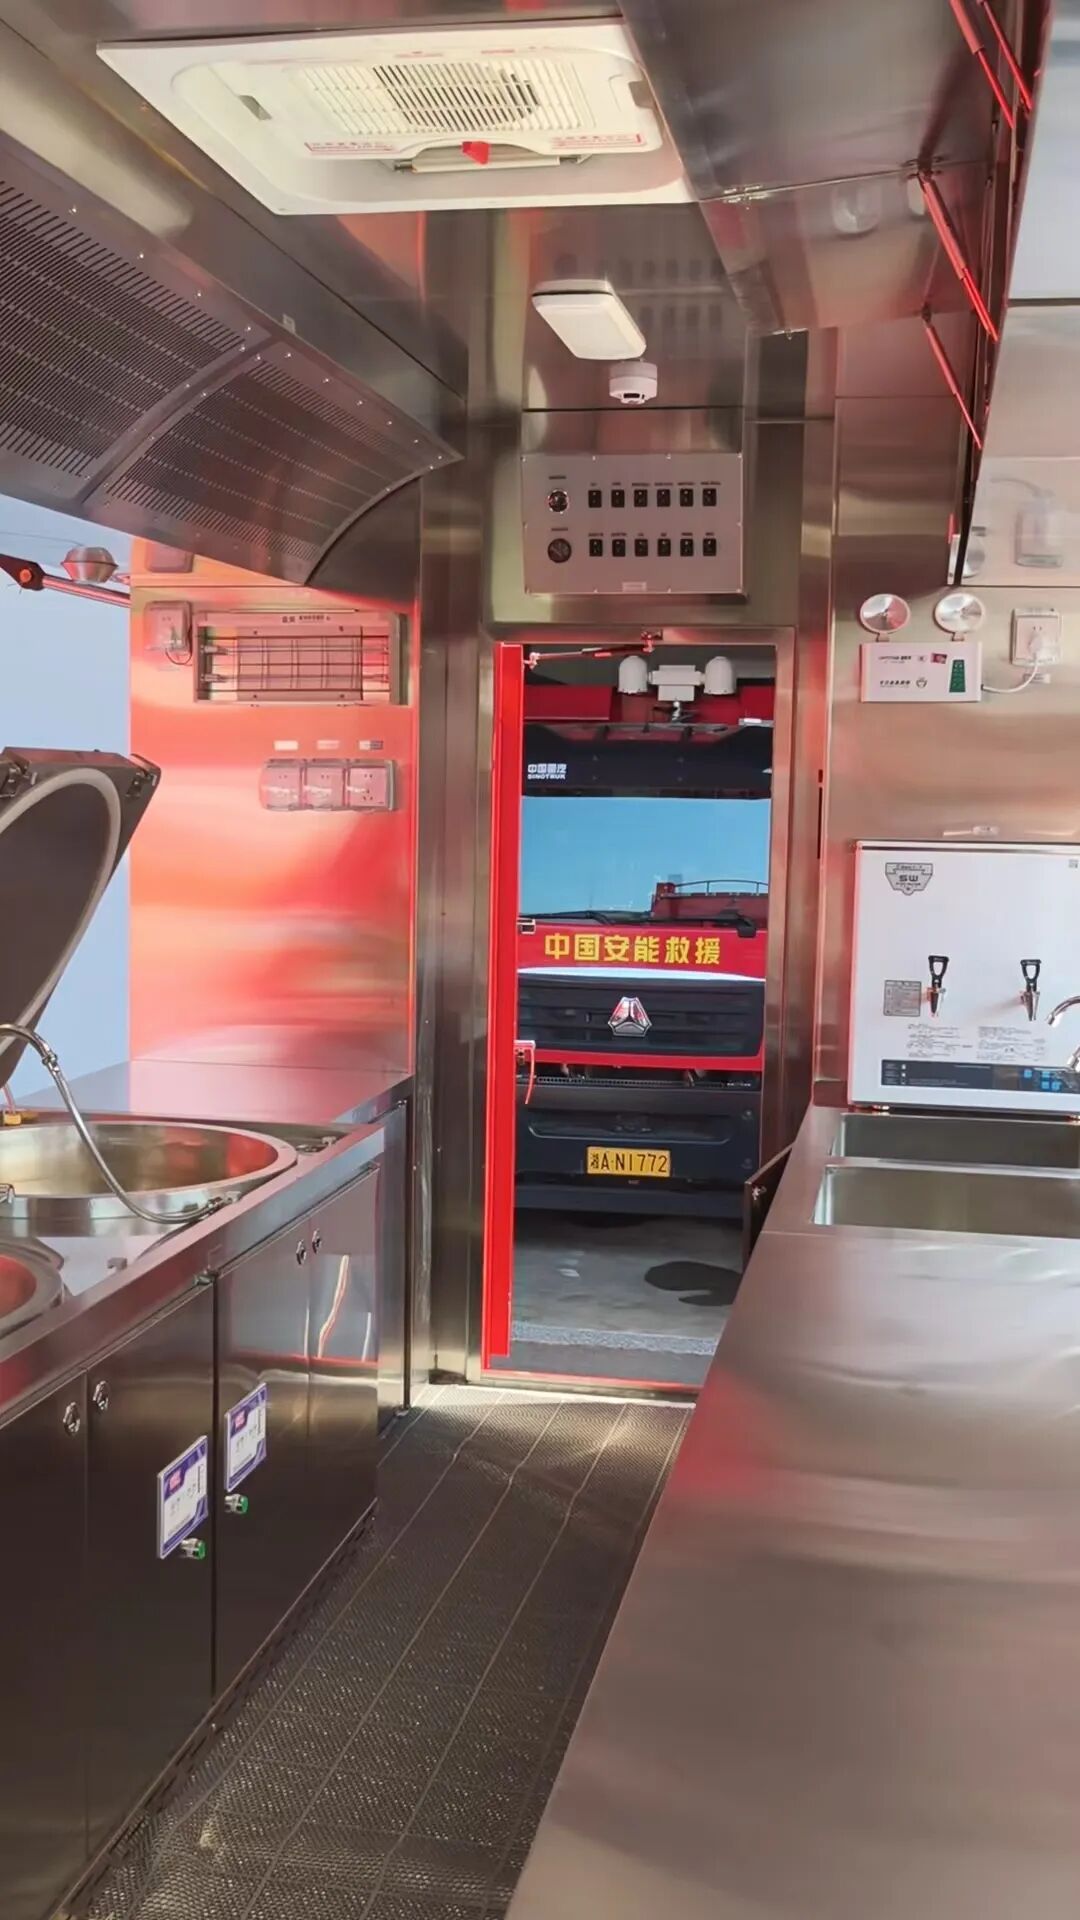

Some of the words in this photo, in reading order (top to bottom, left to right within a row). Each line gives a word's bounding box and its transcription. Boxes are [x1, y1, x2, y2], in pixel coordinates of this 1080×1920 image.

[545, 933, 721, 965] 中国安能救援
